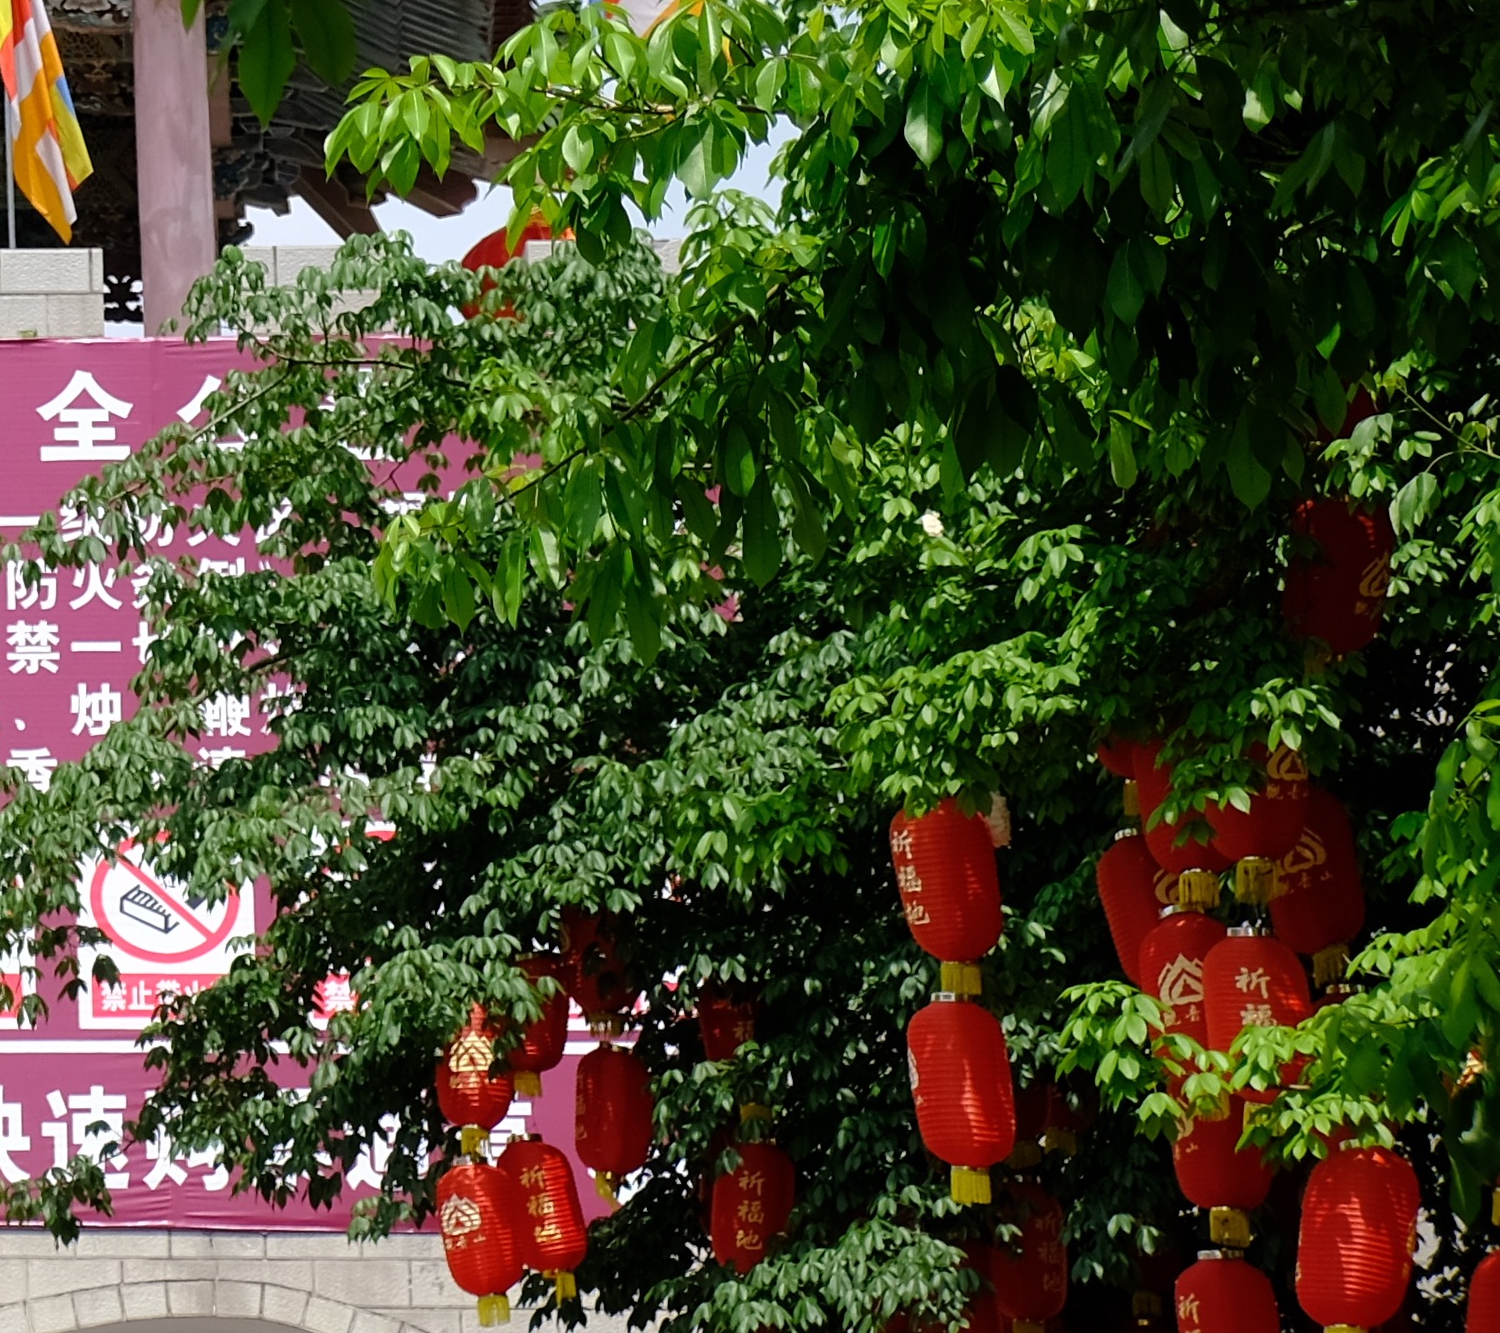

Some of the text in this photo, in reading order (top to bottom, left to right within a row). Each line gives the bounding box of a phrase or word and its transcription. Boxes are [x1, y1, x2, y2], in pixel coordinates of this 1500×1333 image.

[736, 1170, 766, 1251] 祈福地
[1179, 1293, 1201, 1333] 祈
